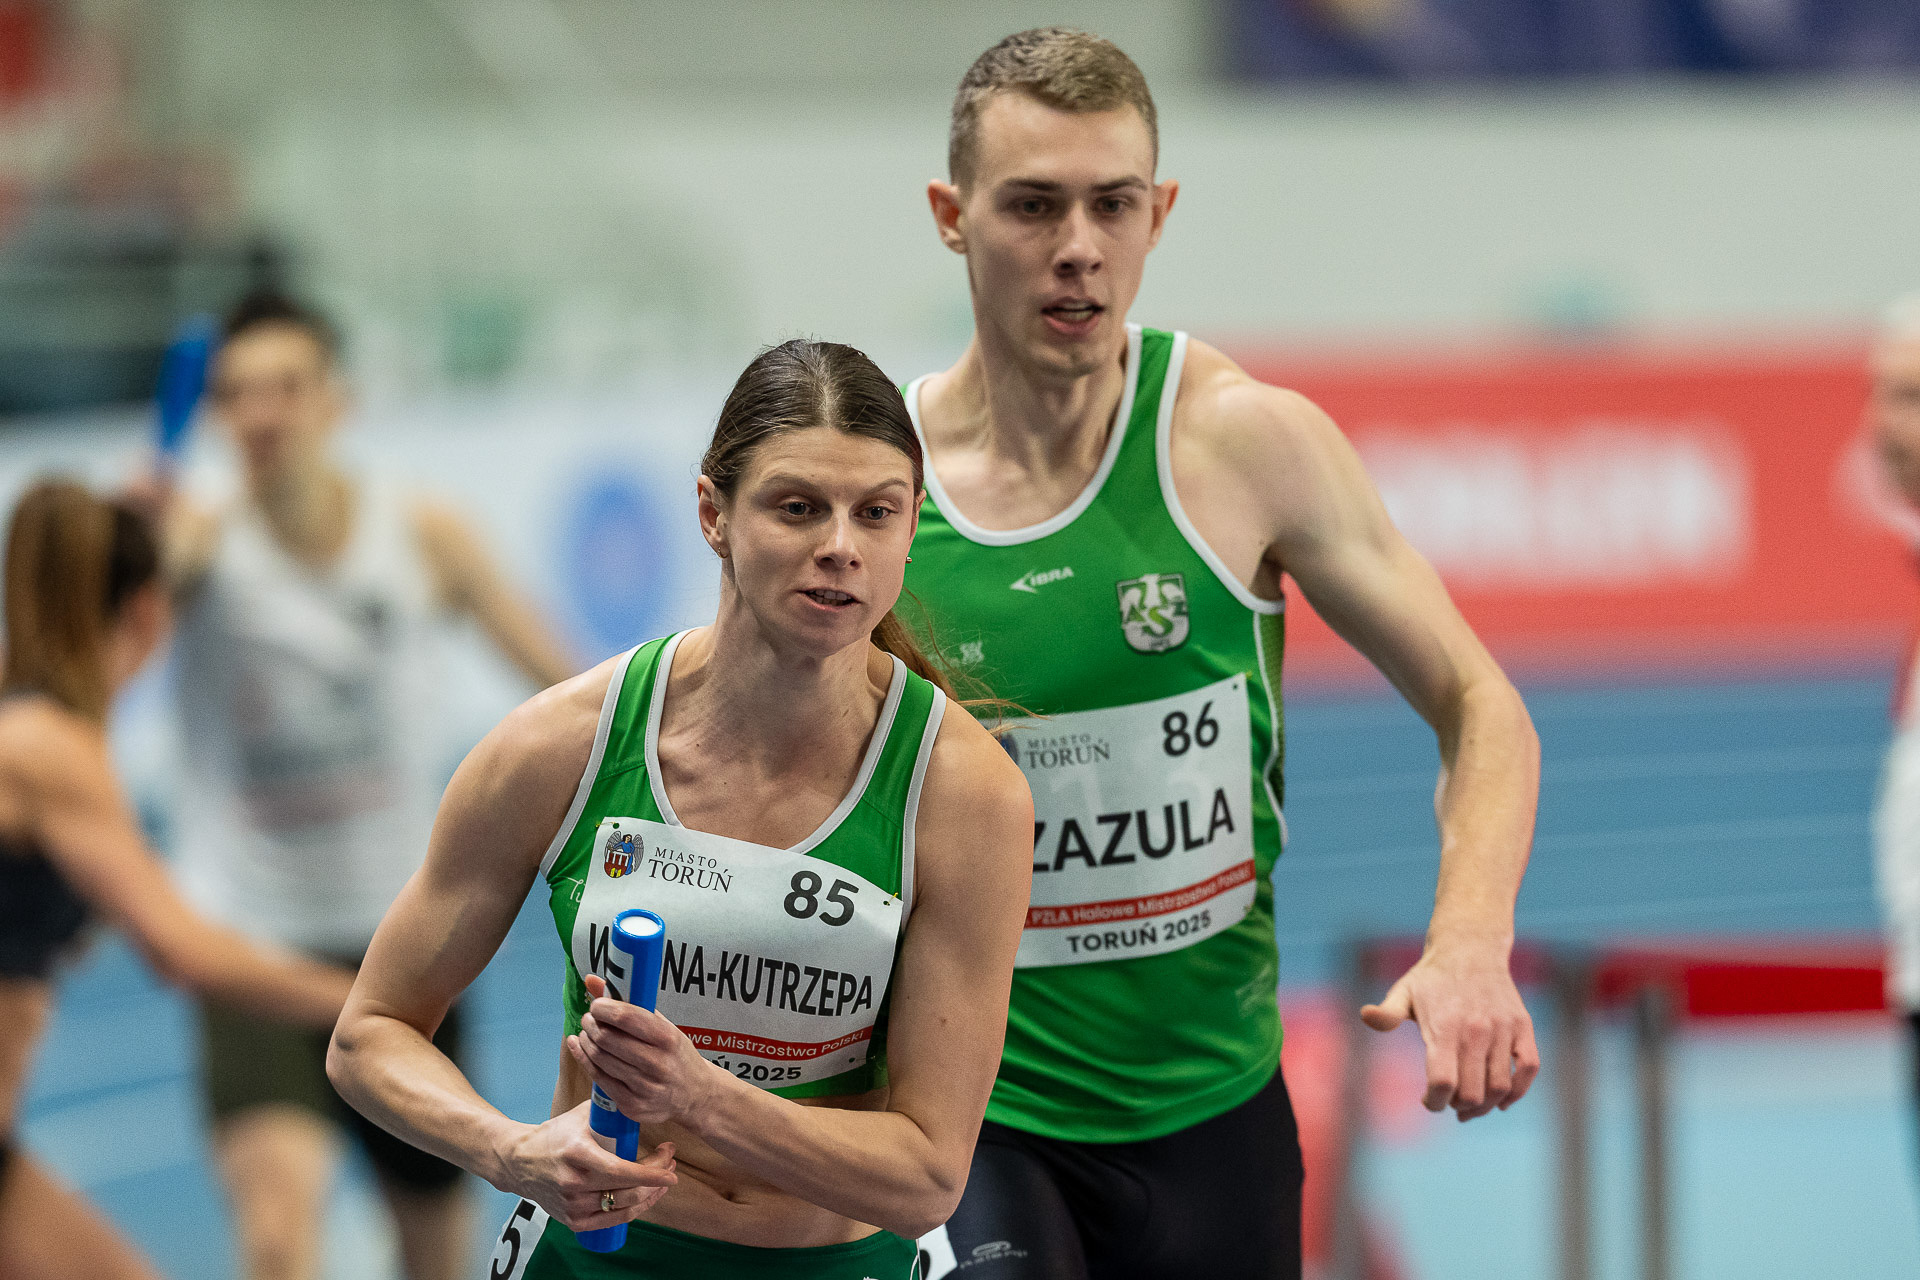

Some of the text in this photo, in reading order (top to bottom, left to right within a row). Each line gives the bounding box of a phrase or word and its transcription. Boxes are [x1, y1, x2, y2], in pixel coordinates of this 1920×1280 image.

[1027, 733, 1091, 749] MIASTO
[1162, 700, 1220, 757] 86
[1024, 739, 1110, 769] TORUŃ
[654, 846, 717, 869] MIASTO
[648, 858, 734, 893] TORUŃ
[783, 870, 859, 927] 85
[1031, 908, 1073, 926] PZLA
[1073, 902, 1135, 922] Halowe
[1066, 909, 1212, 953] TORUŃ 2025
[716, 1034, 817, 1057] Mistrzostwa
[821, 1029, 865, 1054] Polski
[736, 1061, 802, 1082] 2025
[490, 1198, 537, 1280] 5
